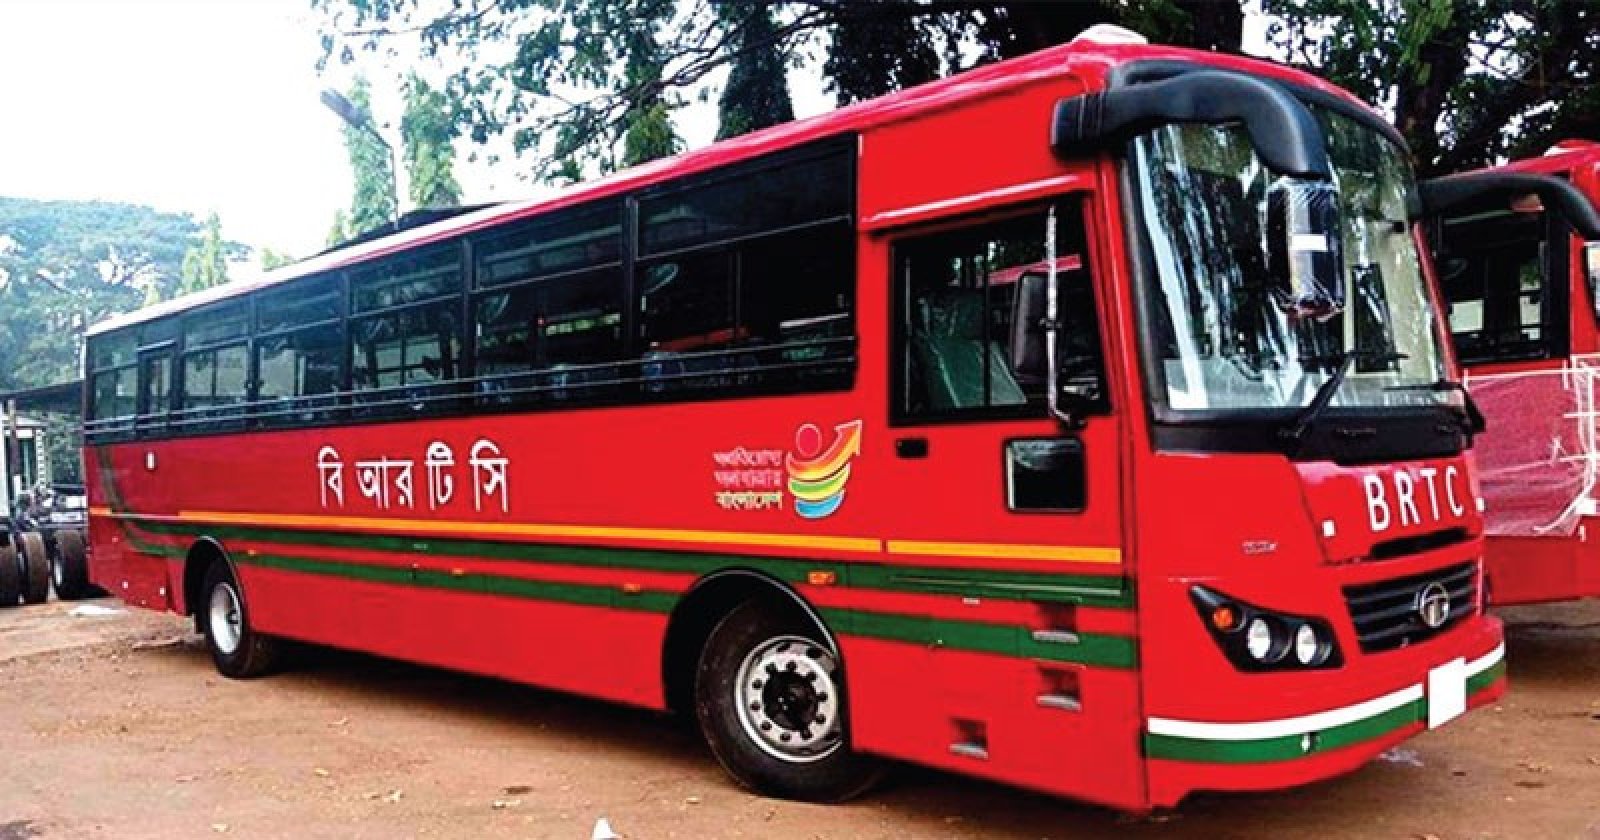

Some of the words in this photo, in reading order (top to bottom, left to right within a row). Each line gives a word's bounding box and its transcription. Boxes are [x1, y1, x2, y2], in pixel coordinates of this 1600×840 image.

[317, 445, 344, 508] বি
[355, 456, 414, 509] আর
[424, 441, 455, 510] টি
[469, 439, 509, 512] সি
[1363, 466, 1463, 531] BRTC
